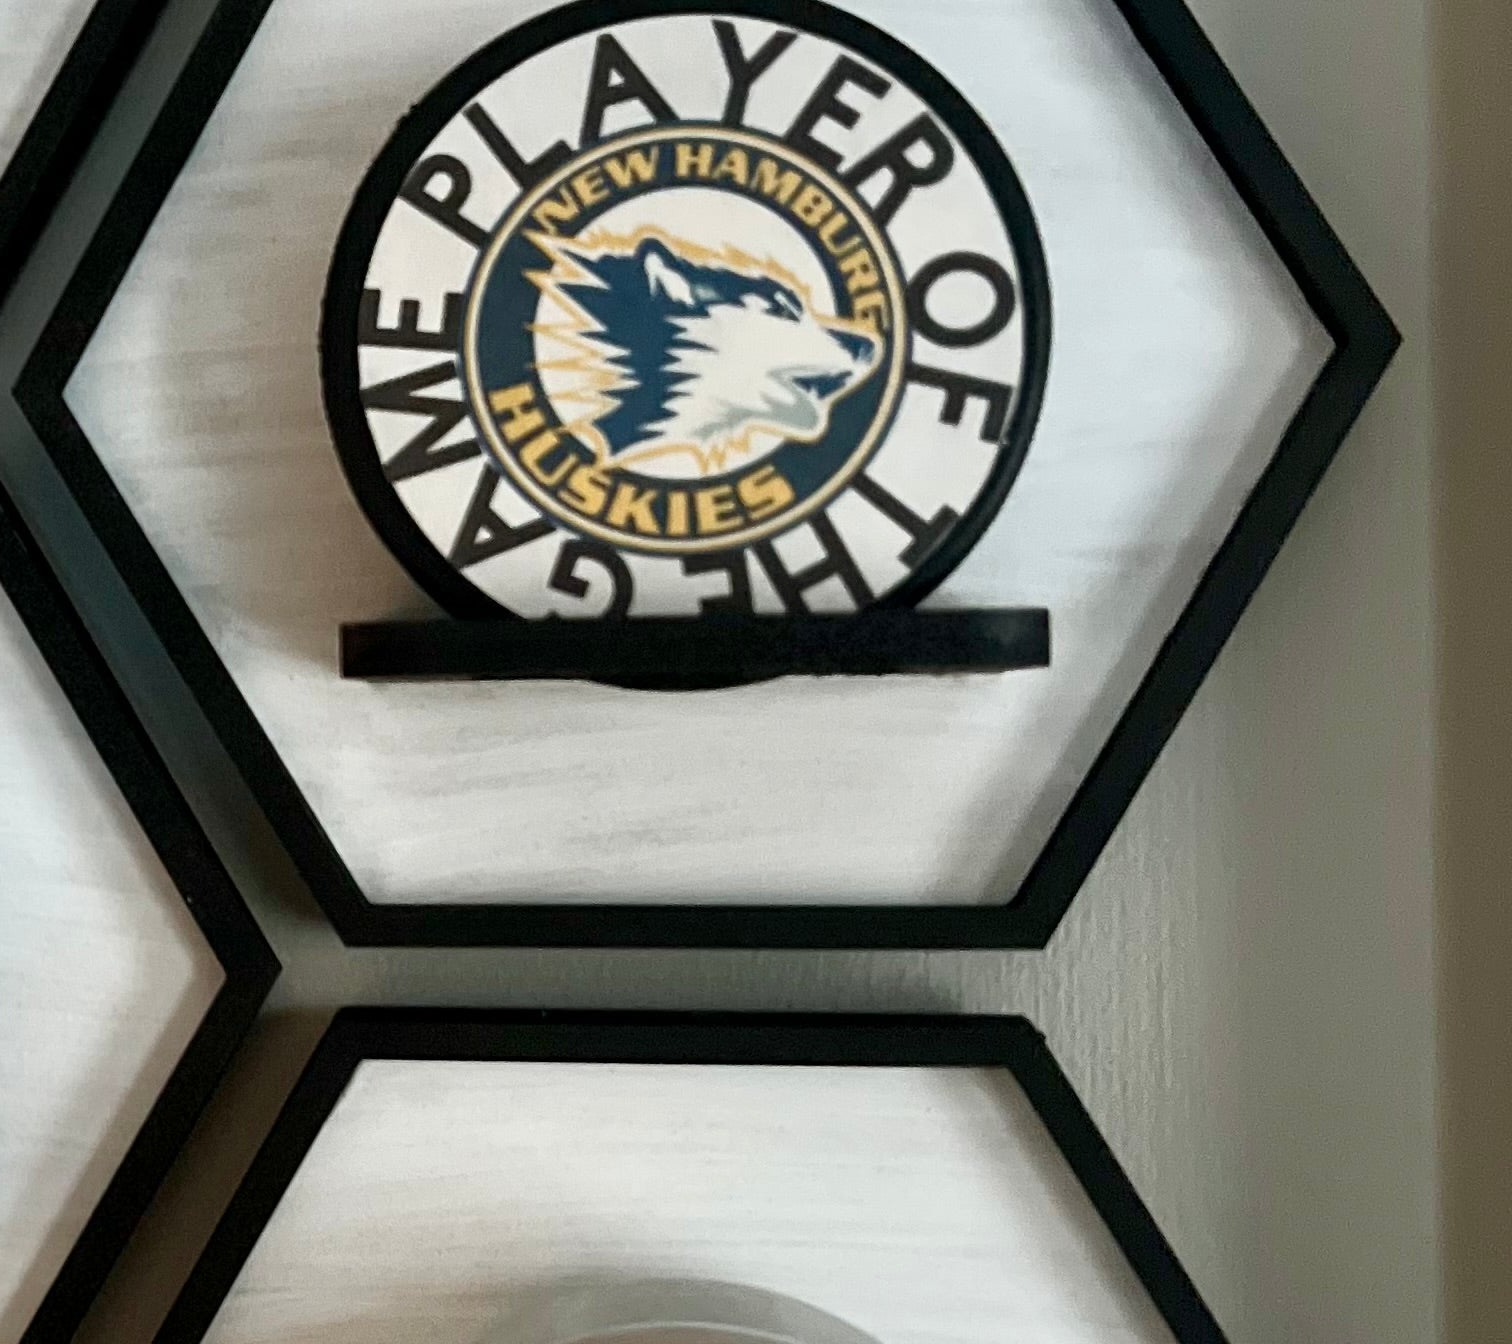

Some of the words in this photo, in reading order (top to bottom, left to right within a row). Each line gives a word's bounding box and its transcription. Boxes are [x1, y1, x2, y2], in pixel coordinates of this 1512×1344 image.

[399, 18, 956, 253] PLAYER
[531, 146, 660, 237] NEW
[905, 251, 1016, 445] OF
[358, 287, 634, 620] GAME
[490, 383, 795, 536] HUSKIES
